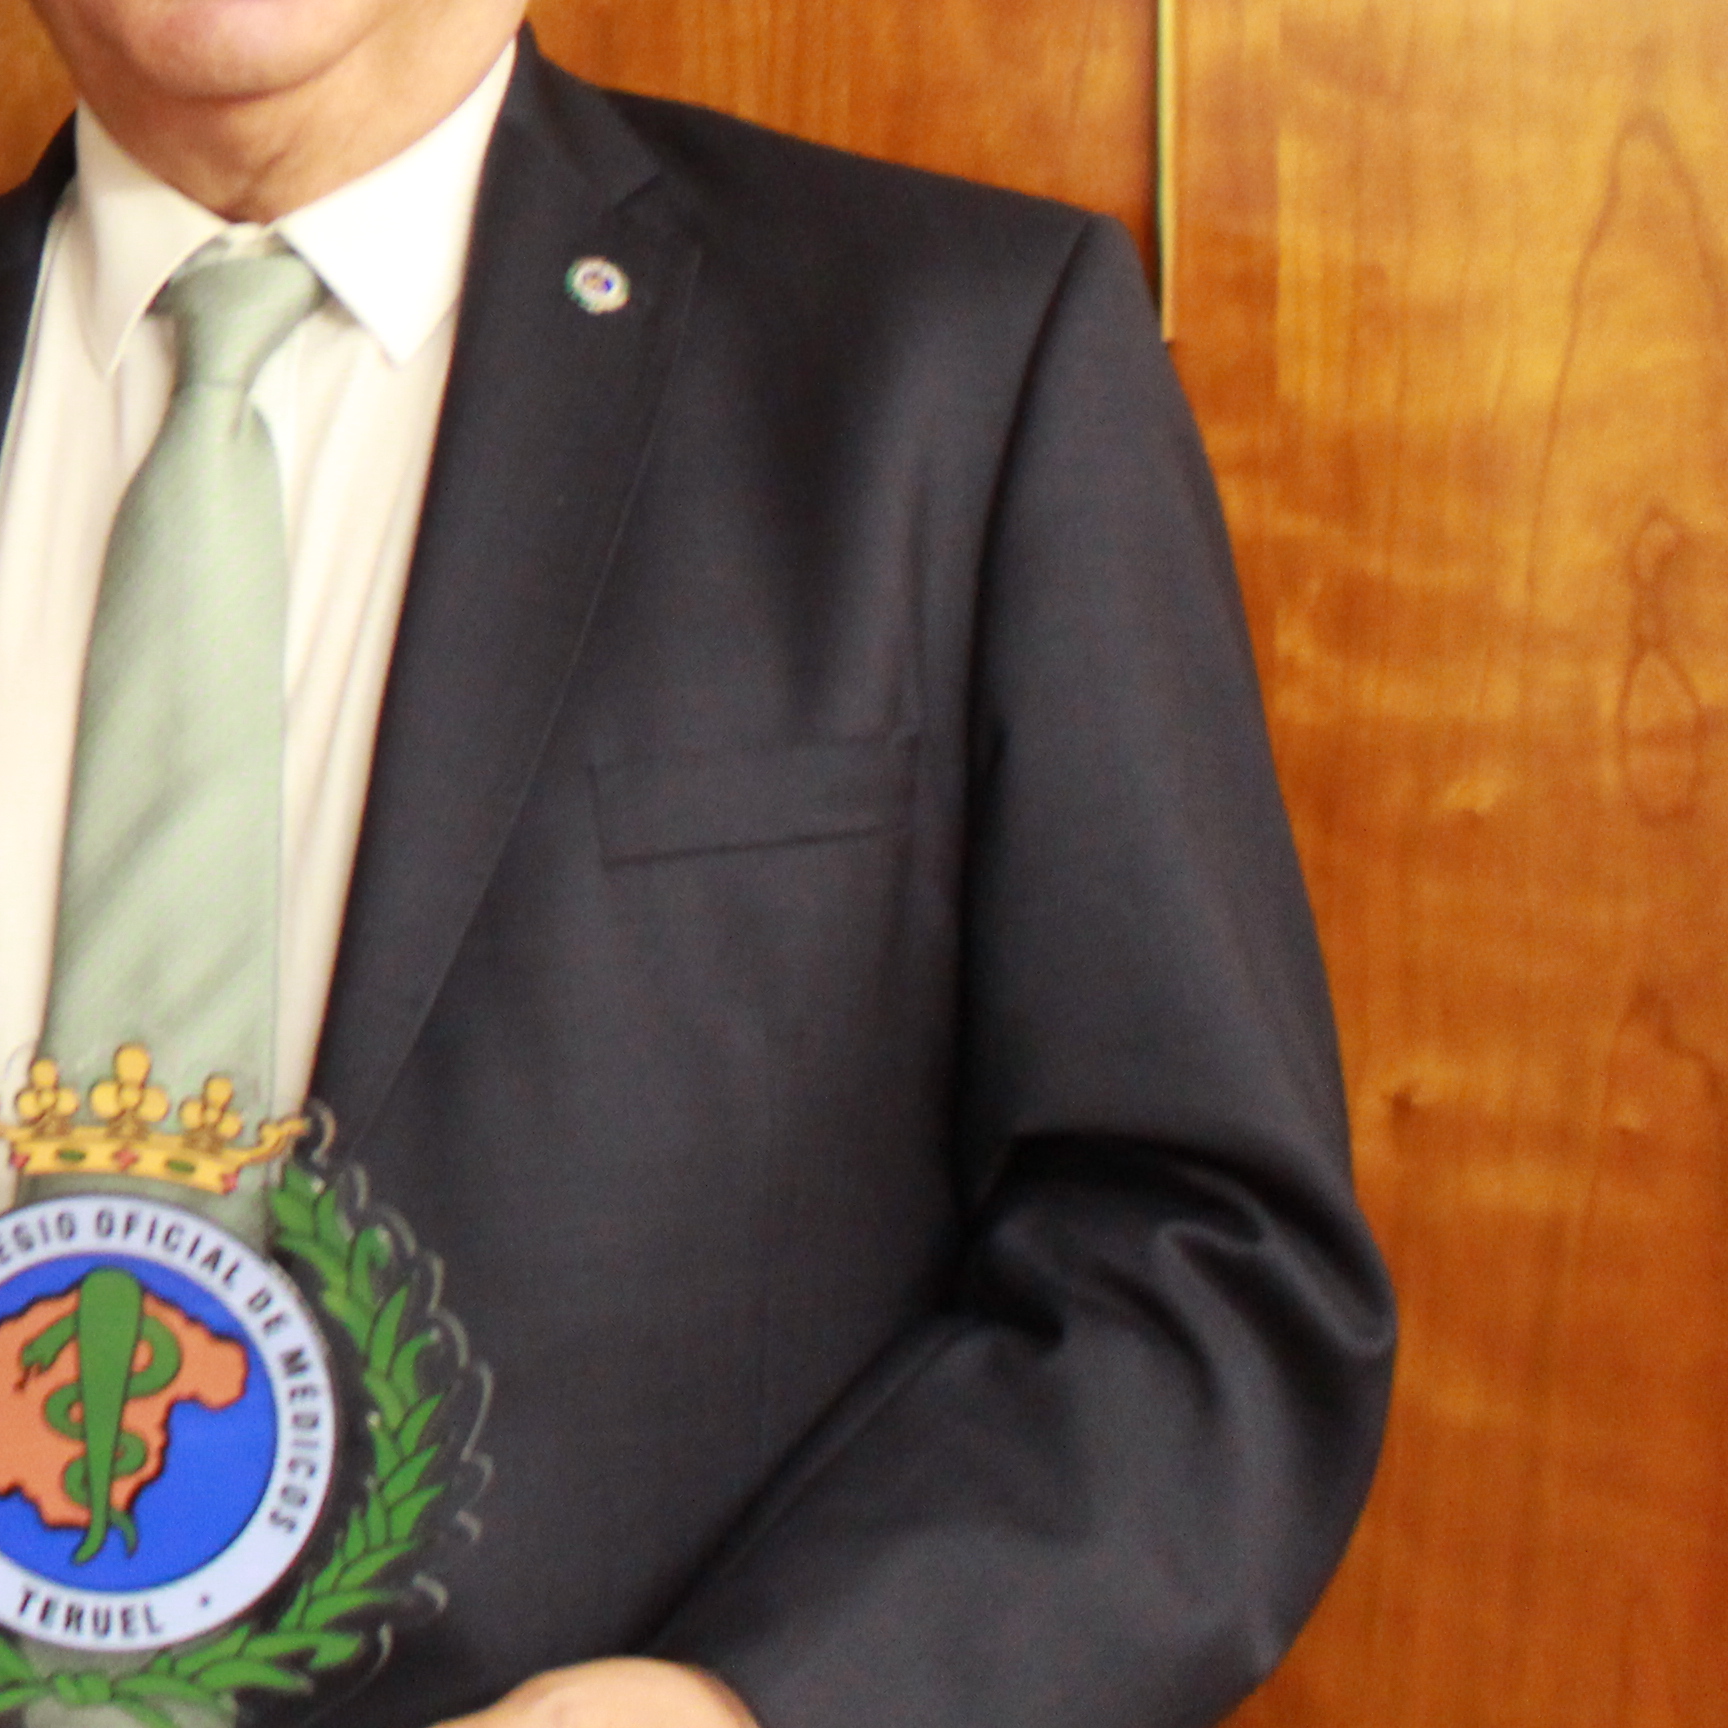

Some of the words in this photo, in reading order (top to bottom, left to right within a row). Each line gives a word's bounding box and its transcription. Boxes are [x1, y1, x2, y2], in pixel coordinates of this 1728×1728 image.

[96, 1208, 242, 1289] OFICIAL
[246, 1285, 287, 1337] DE
[18, 1584, 164, 1638] TERUEL
